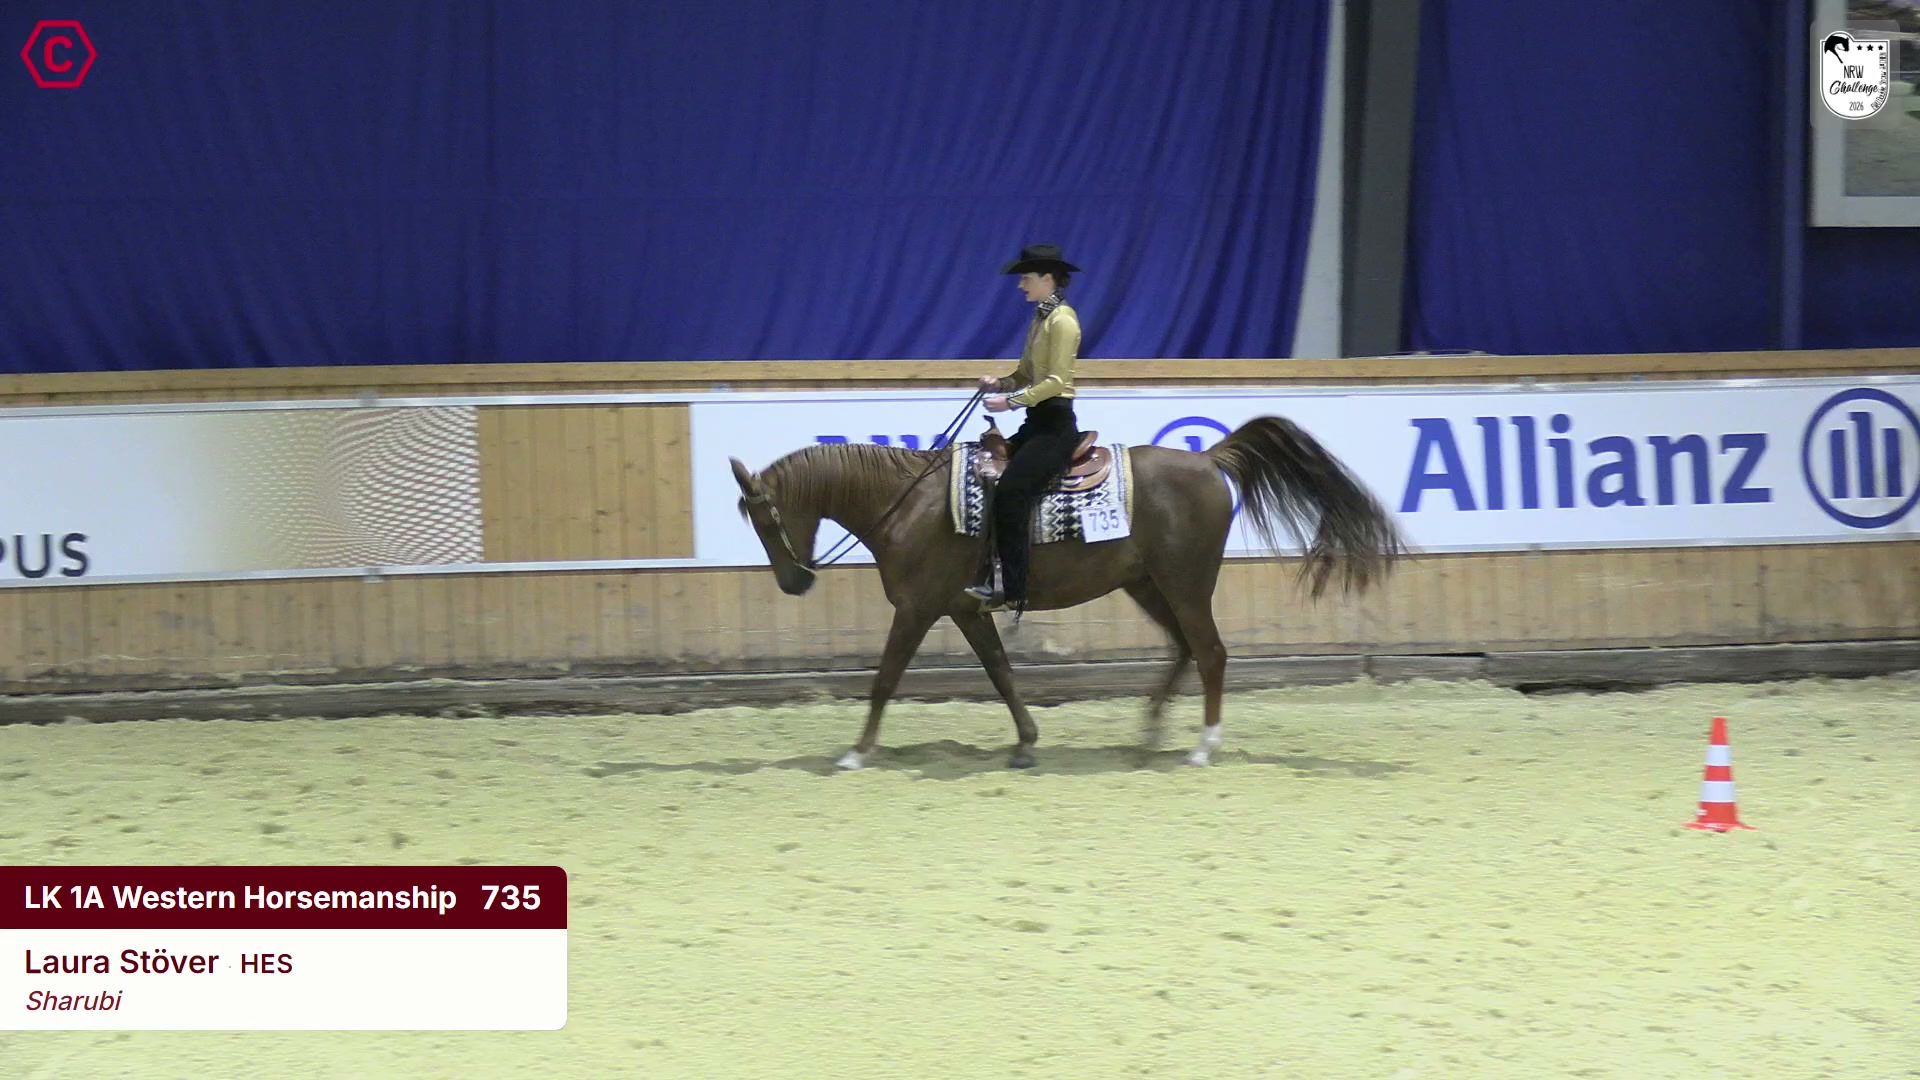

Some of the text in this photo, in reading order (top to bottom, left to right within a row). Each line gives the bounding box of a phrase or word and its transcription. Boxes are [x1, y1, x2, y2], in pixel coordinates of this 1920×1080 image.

[1398, 413, 1774, 513] Allianz
[1088, 509, 1120, 532] 735
[0, 532, 90, 579] US
